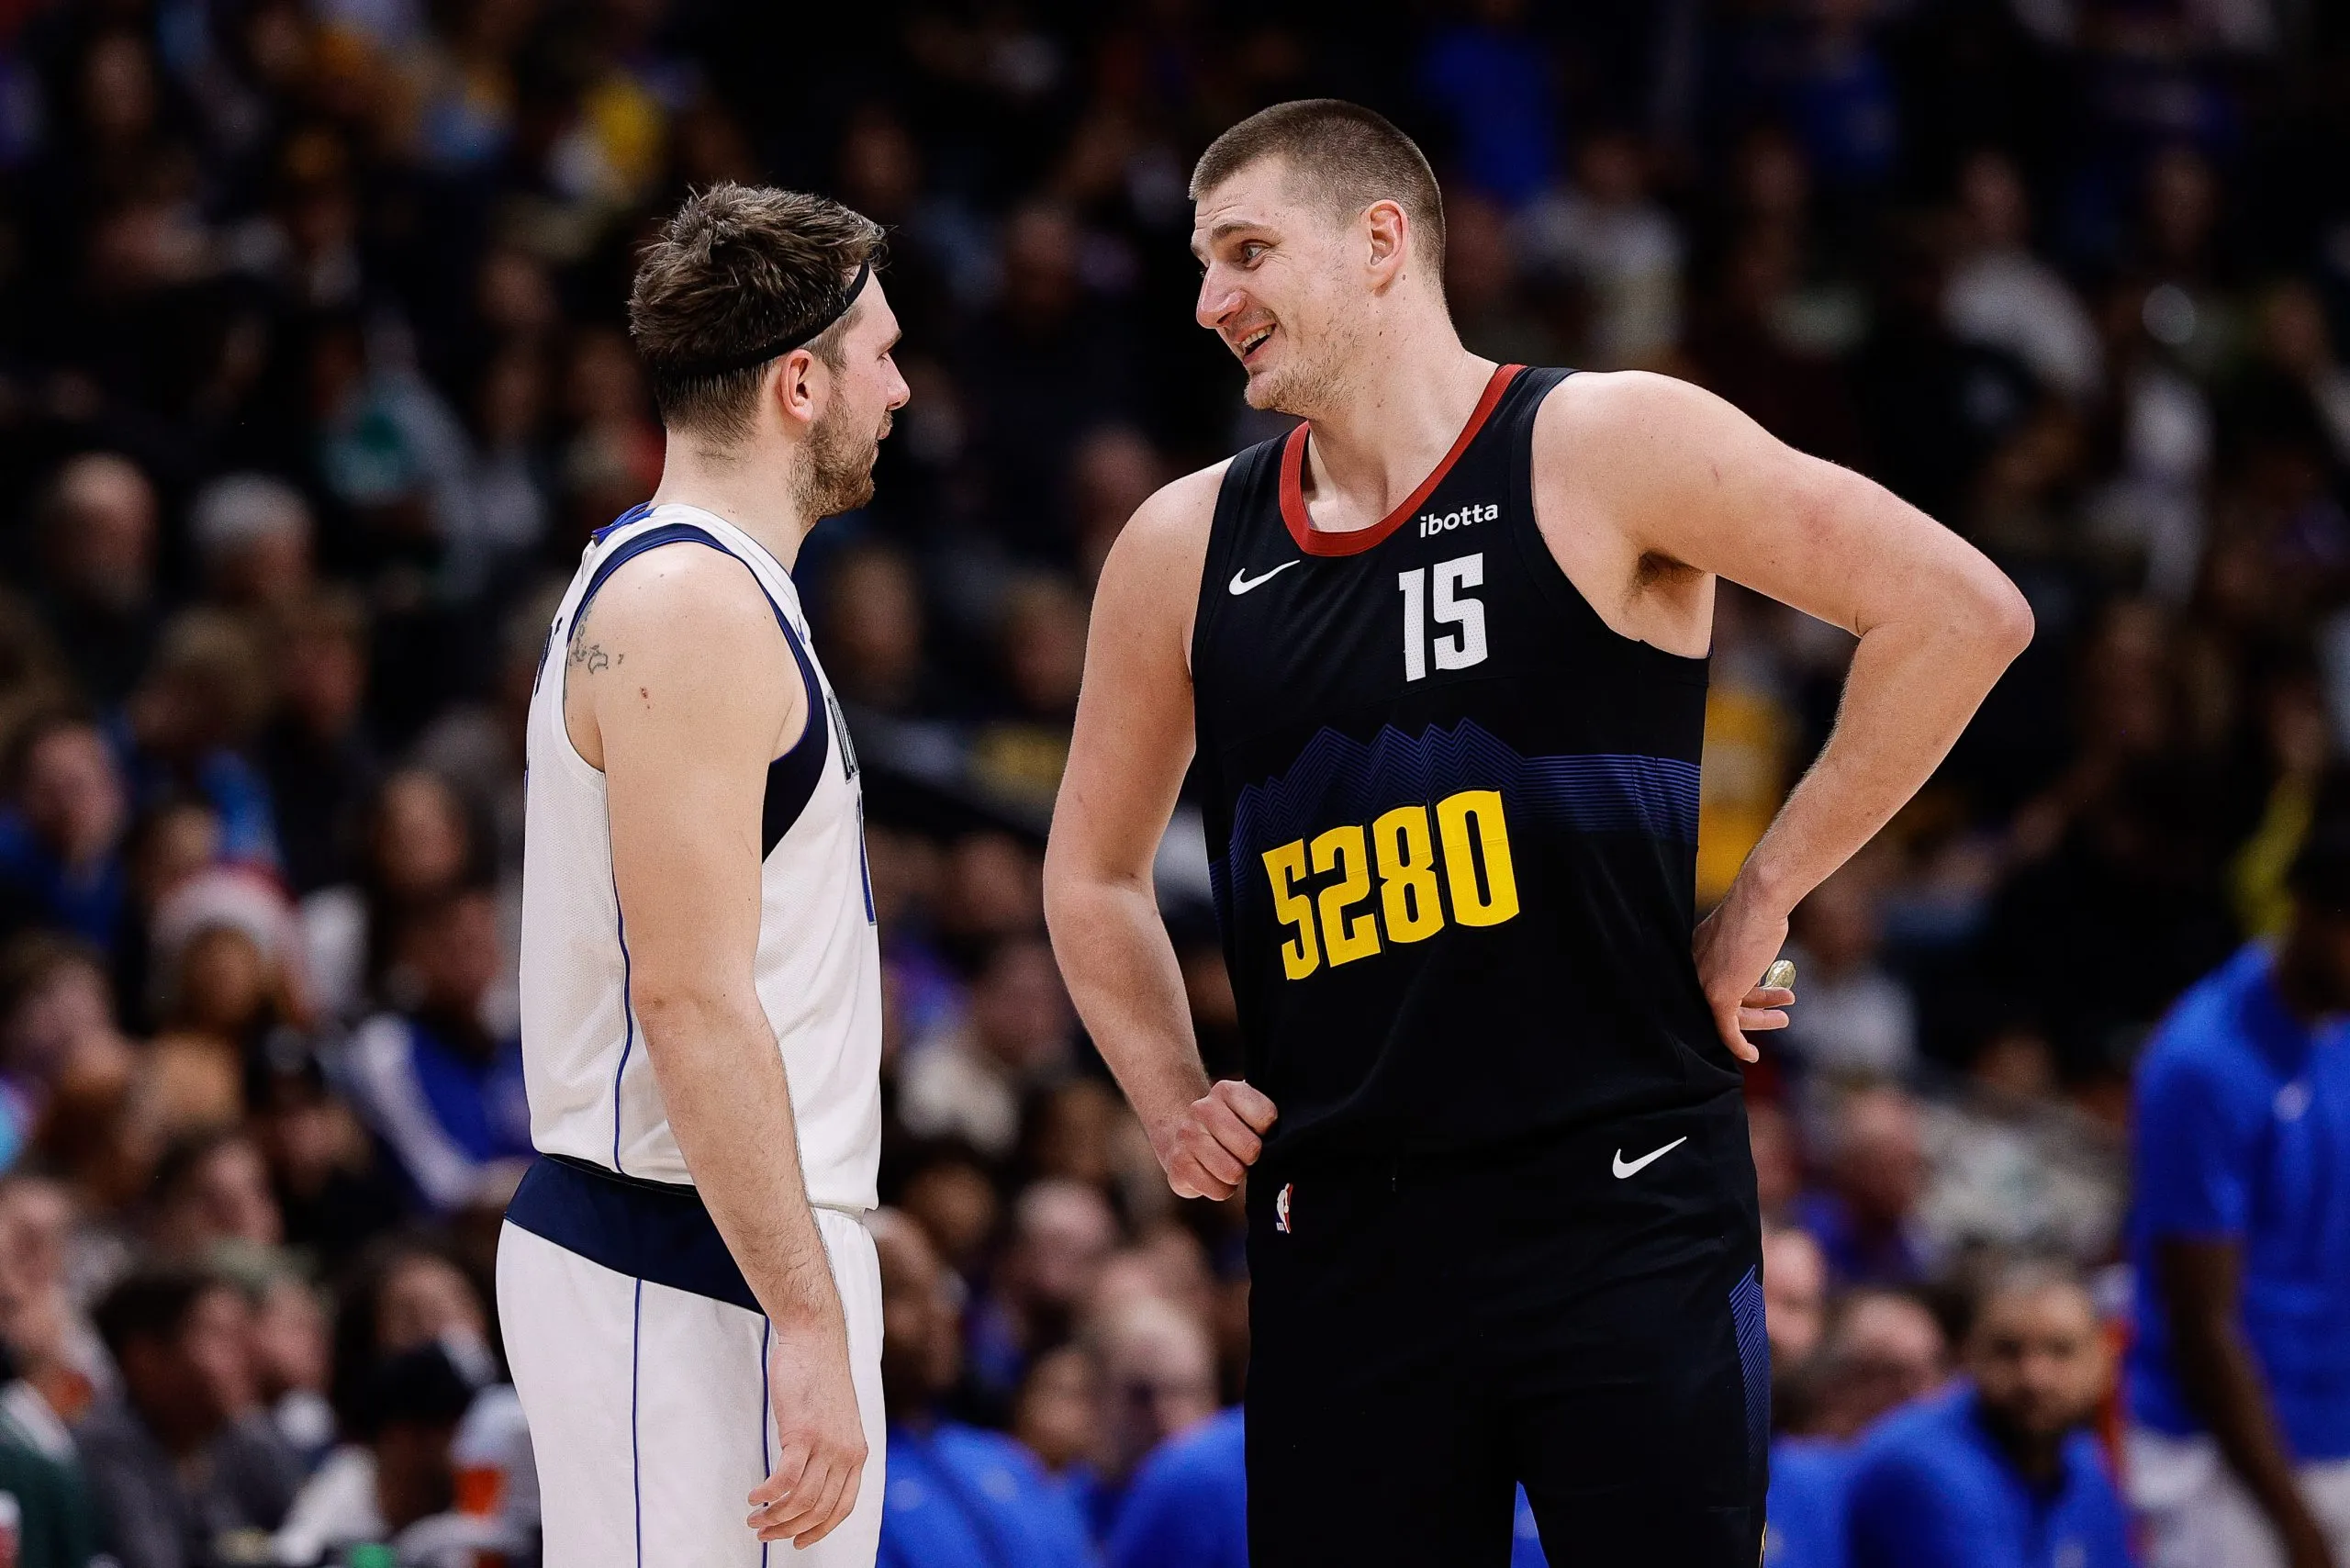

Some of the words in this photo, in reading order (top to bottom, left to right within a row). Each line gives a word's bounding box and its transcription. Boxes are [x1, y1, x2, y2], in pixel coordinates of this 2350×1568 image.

[1420, 503, 1499, 539] ibotta
[1398, 552, 1488, 683] 15
[1261, 790, 1520, 980] 5280
